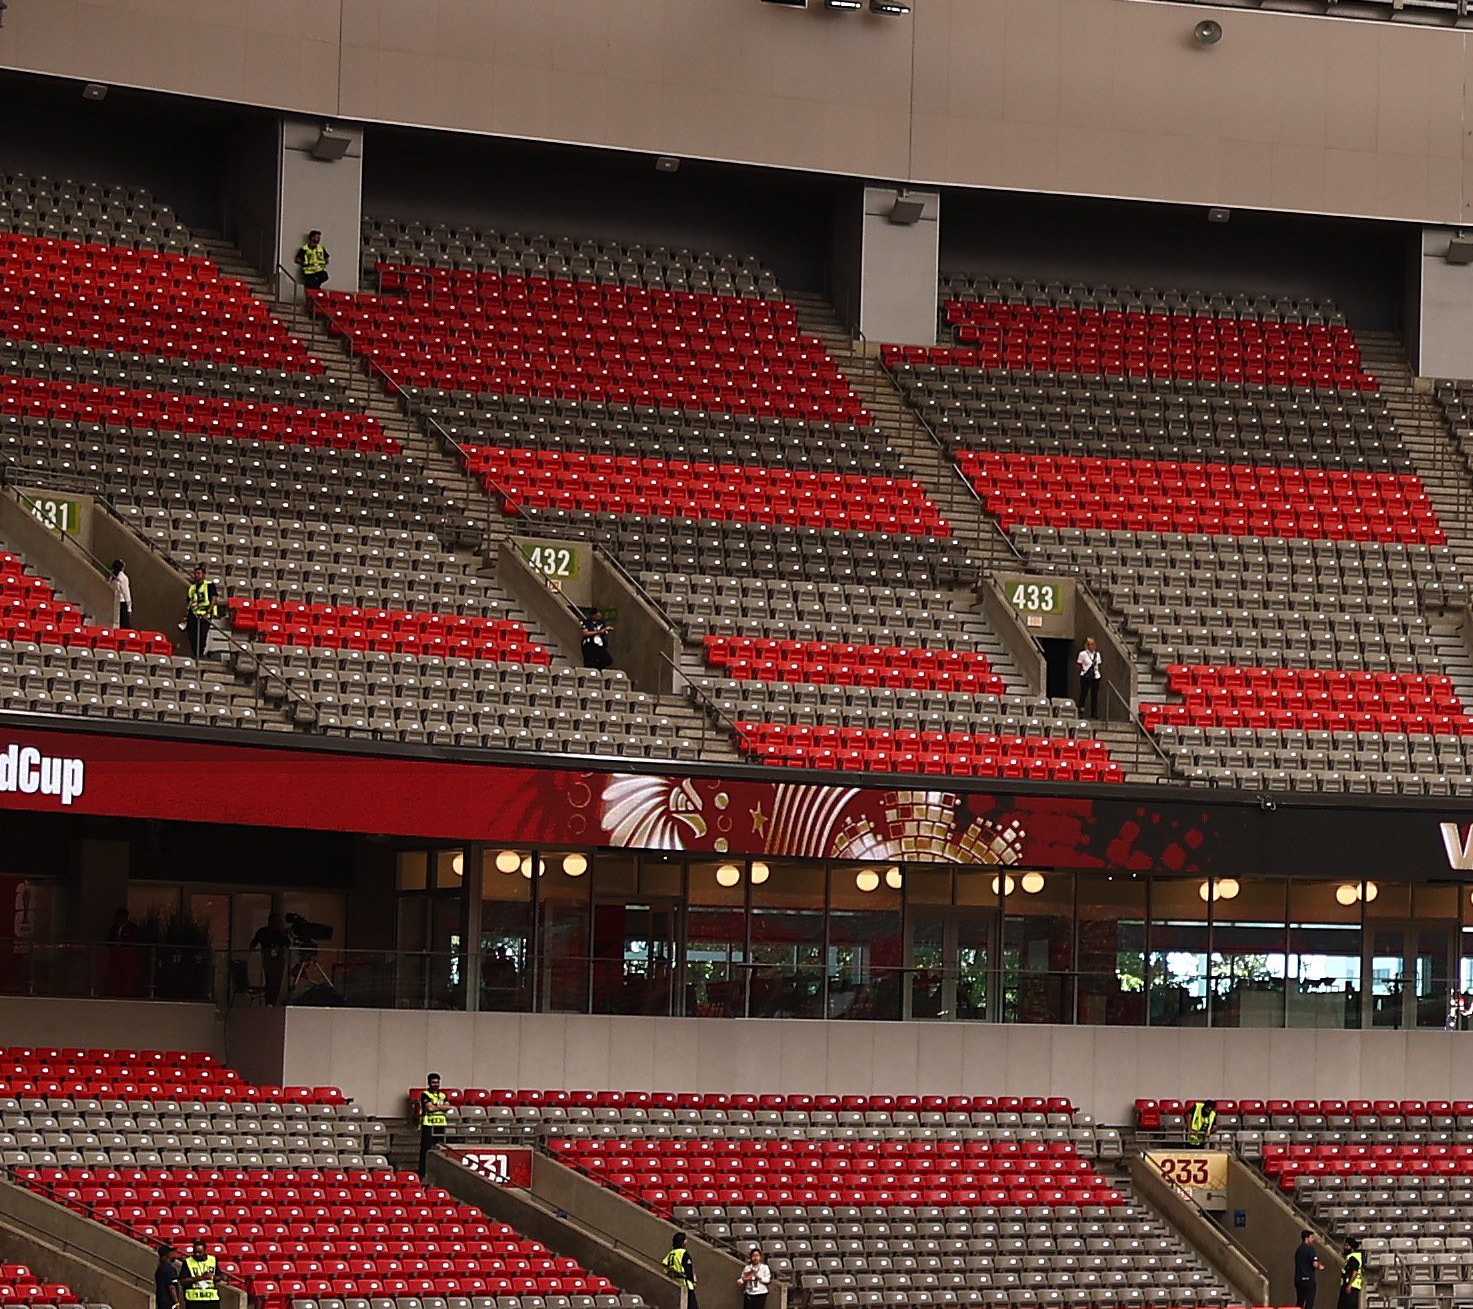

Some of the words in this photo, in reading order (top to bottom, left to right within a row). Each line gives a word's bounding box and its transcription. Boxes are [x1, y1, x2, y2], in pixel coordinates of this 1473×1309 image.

[529, 547, 570, 577] 432
[1012, 584, 1054, 611] 433
[1160, 1158, 1209, 1185] 233
